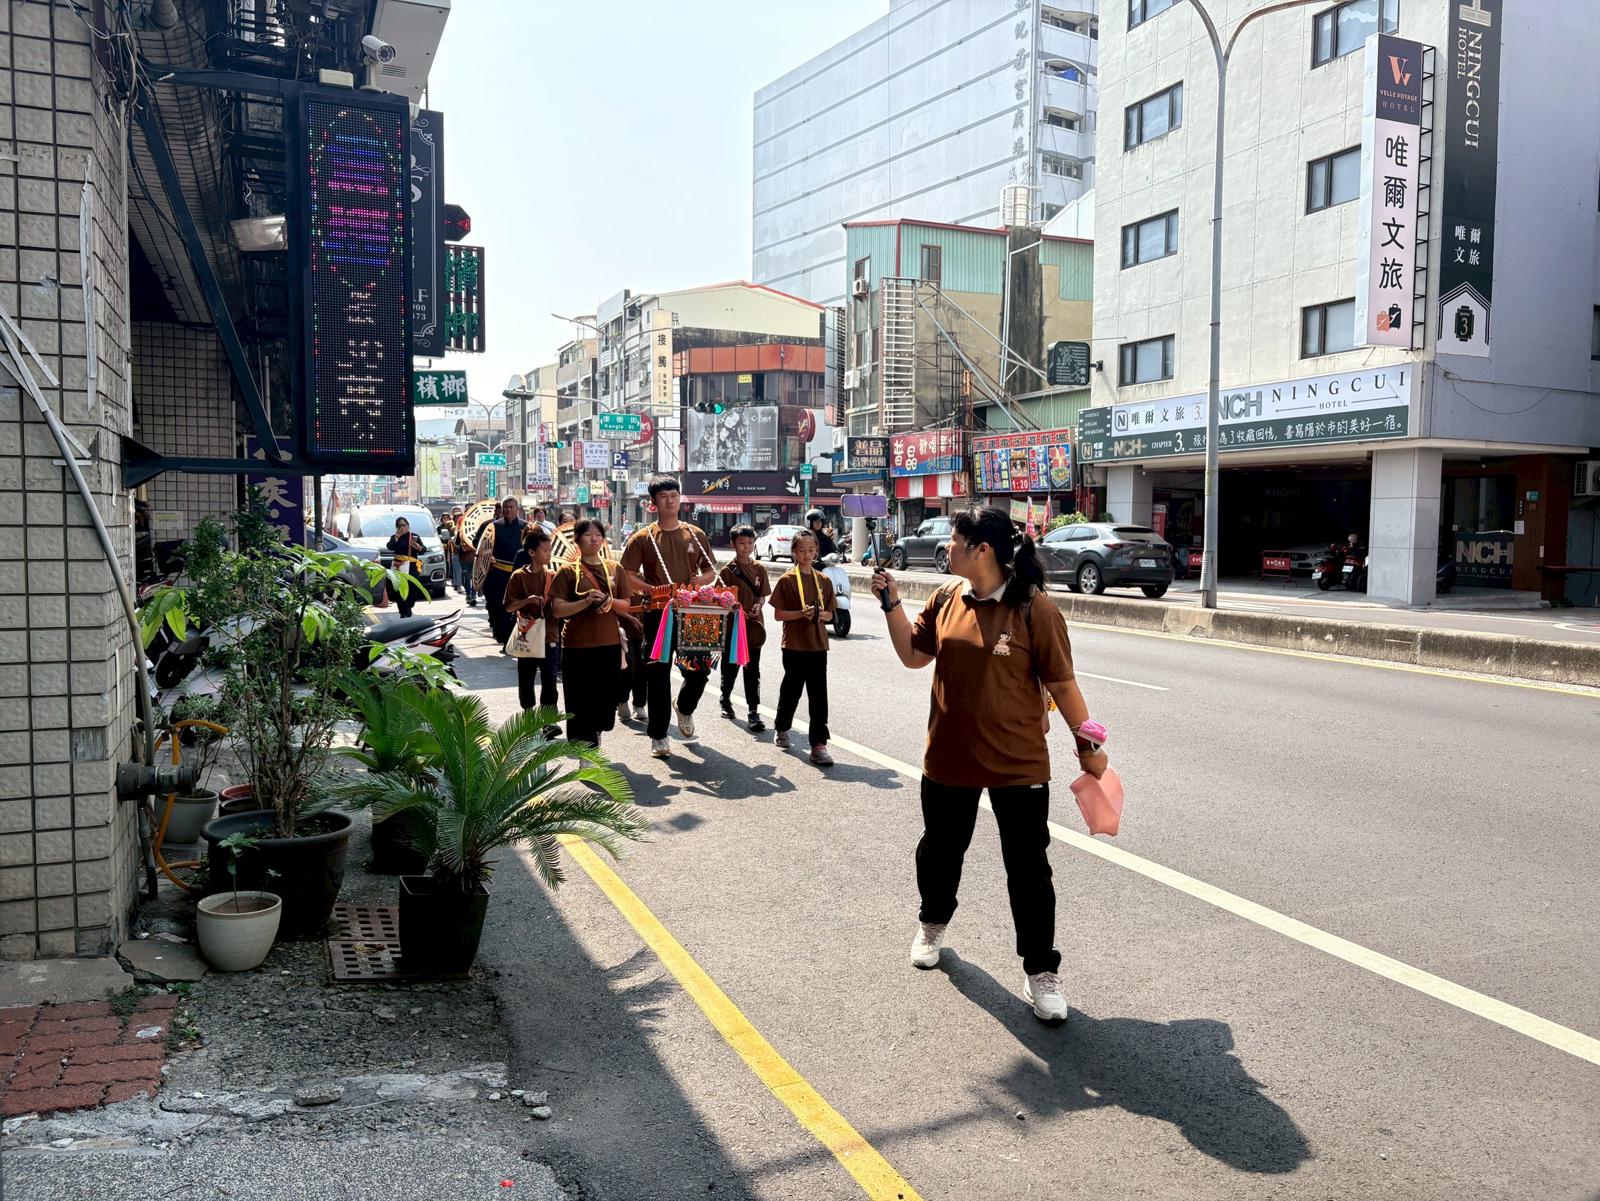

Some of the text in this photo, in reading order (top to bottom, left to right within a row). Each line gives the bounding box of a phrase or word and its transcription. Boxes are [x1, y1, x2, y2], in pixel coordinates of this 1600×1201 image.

[1457, 27, 1467, 79] HOTEL
[1380, 89, 1418, 101] VELLE VOYAGE
[1465, 29, 1483, 149] NINGCUI
[1383, 101, 1414, 113] HOTEL
[1379, 135, 1408, 290] 唯爾文旅
[1455, 225, 1481, 244] 唯爾
[1454, 247, 1480, 266] 文旅
[1460, 317, 1469, 336] 3
[416, 374, 466, 401] 檳榔
[1271, 371, 1405, 403] NINGCUI
[1319, 400, 1348, 410] HOTEL
[1131, 406, 1185, 426] 唯爾文旅
[1012, 480, 1029, 490] 1:20
[1456, 540, 1514, 565] NCH
[1456, 566, 1513, 576] NINGCUI
